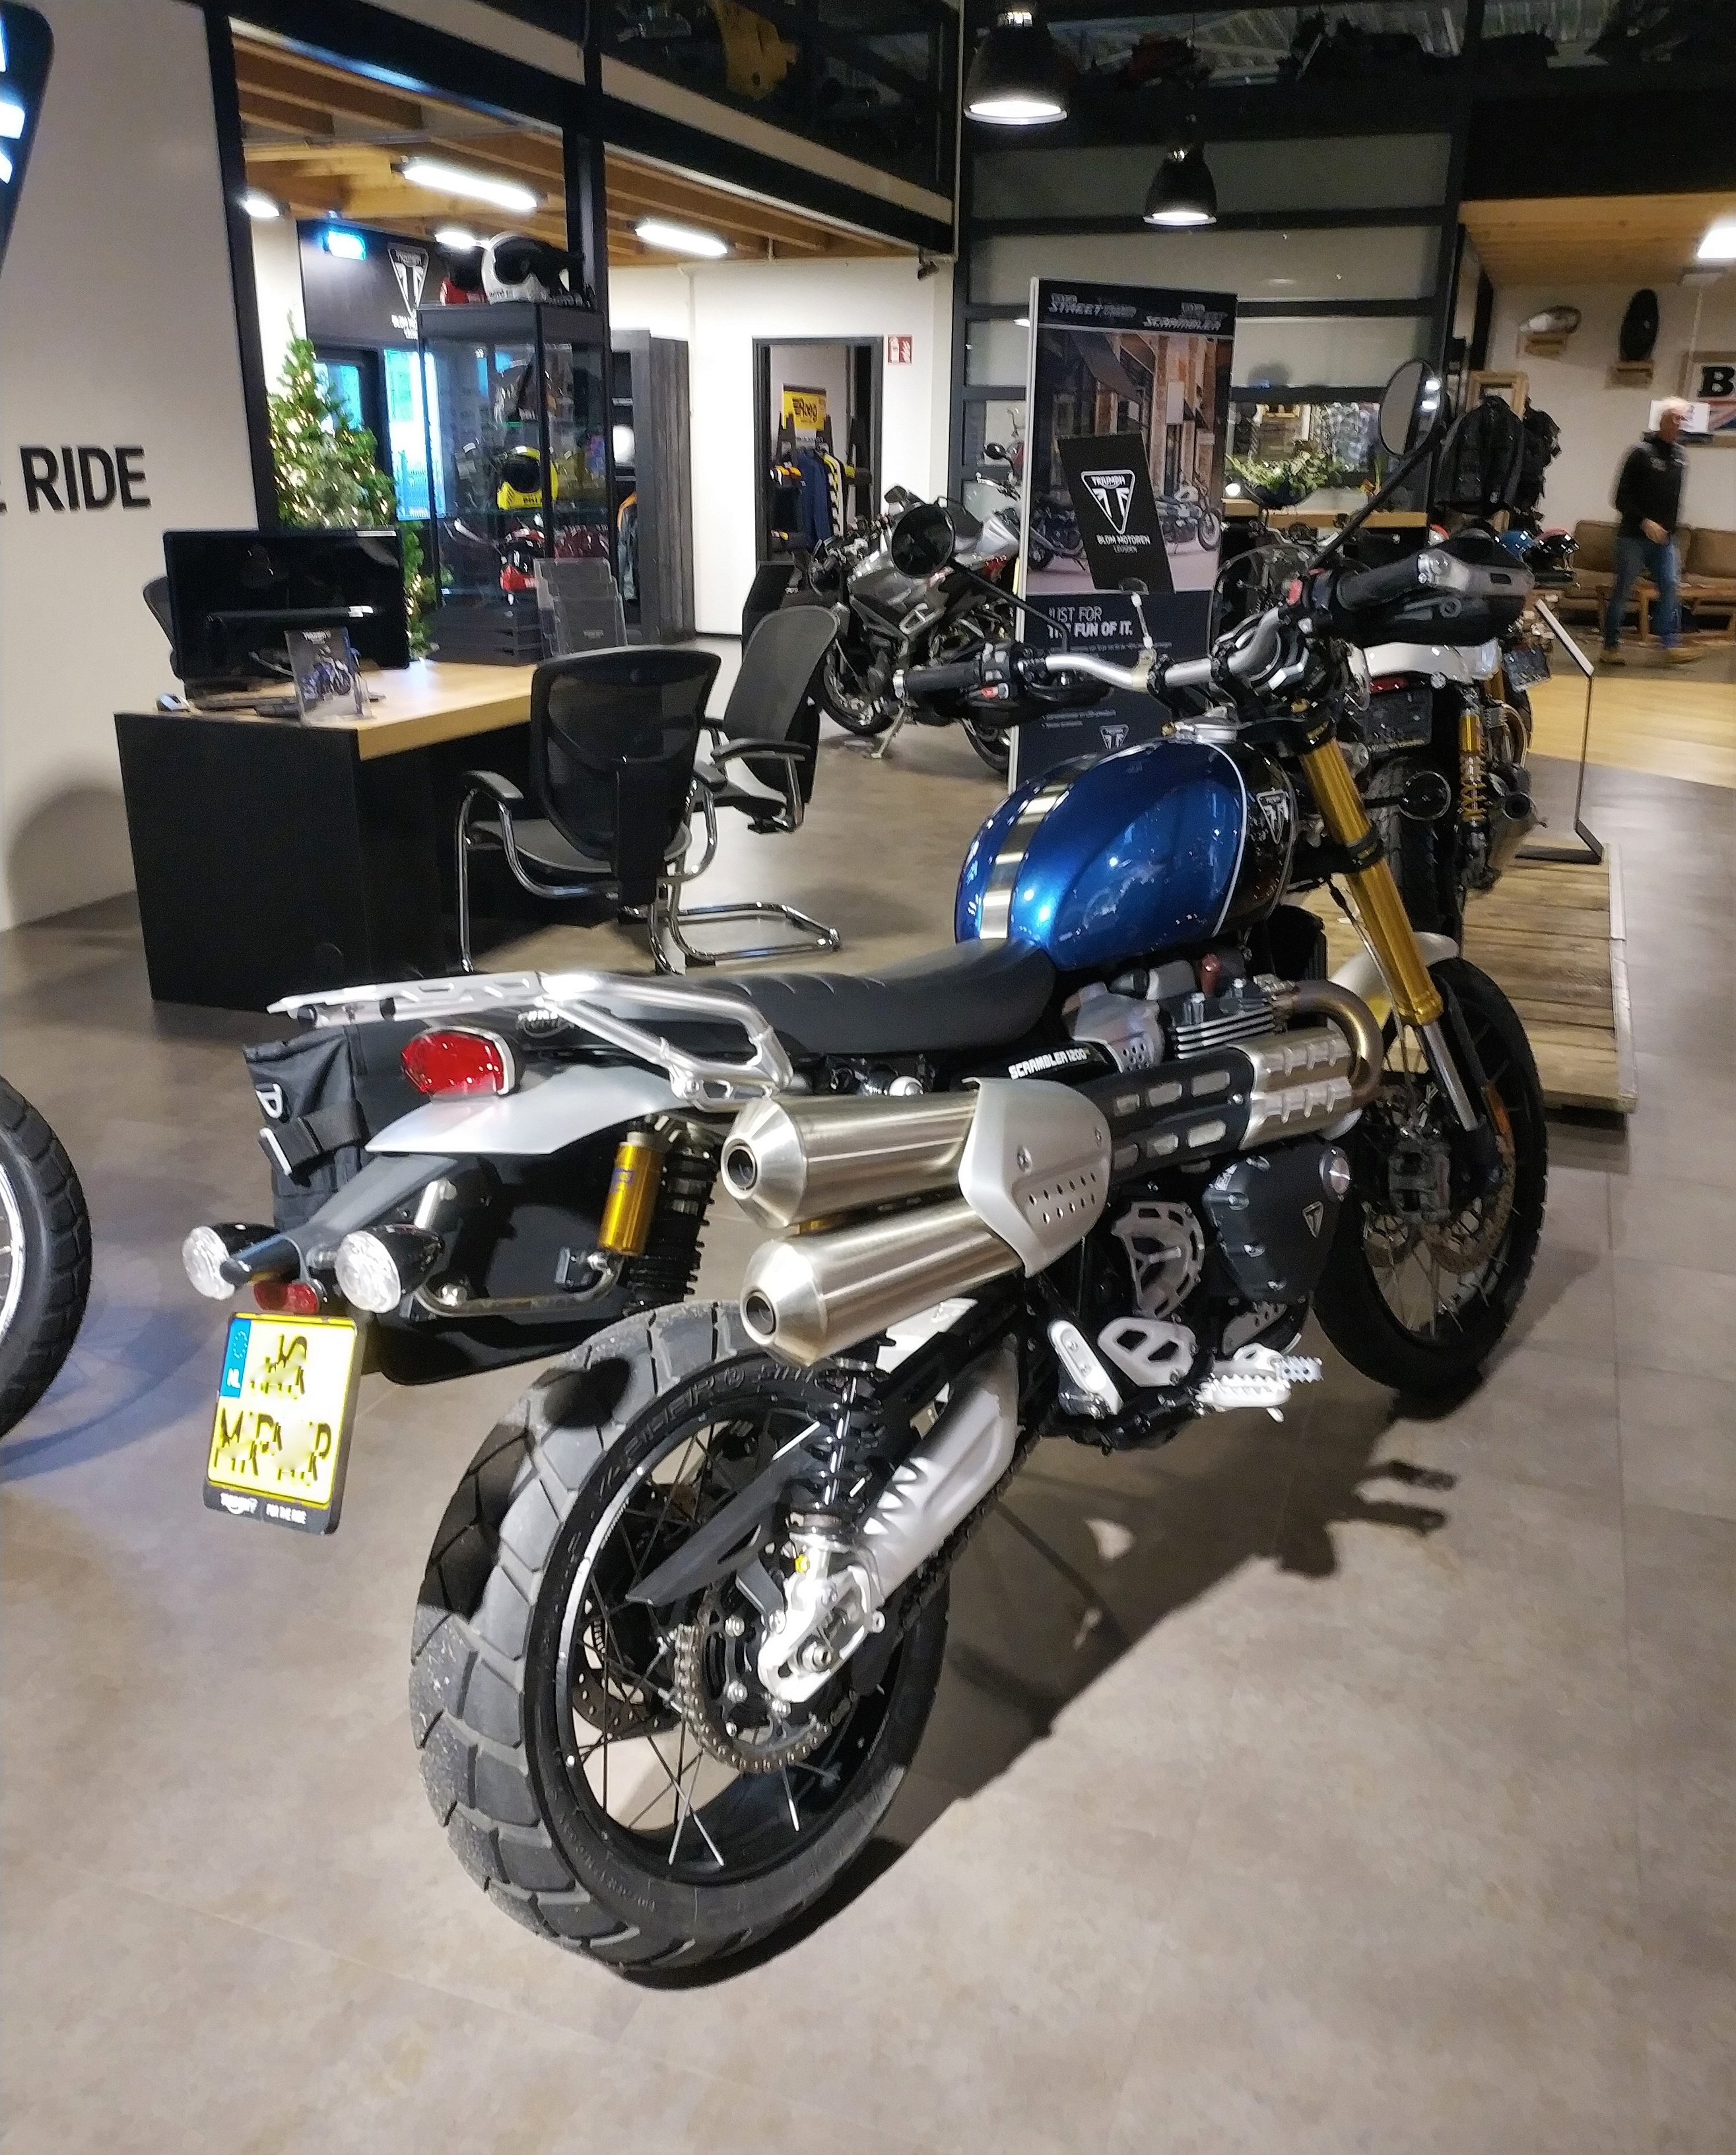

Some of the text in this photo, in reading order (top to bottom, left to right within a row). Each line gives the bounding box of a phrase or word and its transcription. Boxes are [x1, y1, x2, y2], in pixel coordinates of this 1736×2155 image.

[20, 446, 152, 514] RIDE
[1090, 475, 1126, 487] TRIUMPH
[1096, 535, 1151, 545] BLOM MOTOREN
[1078, 605, 1102, 622] FOR
[1073, 622, 1099, 638] FUN
[1100, 621, 1118, 636] OF
[1119, 620, 1133, 636] IT.
[1008, 1048, 1088, 1080] SCRAMBLER 1200
